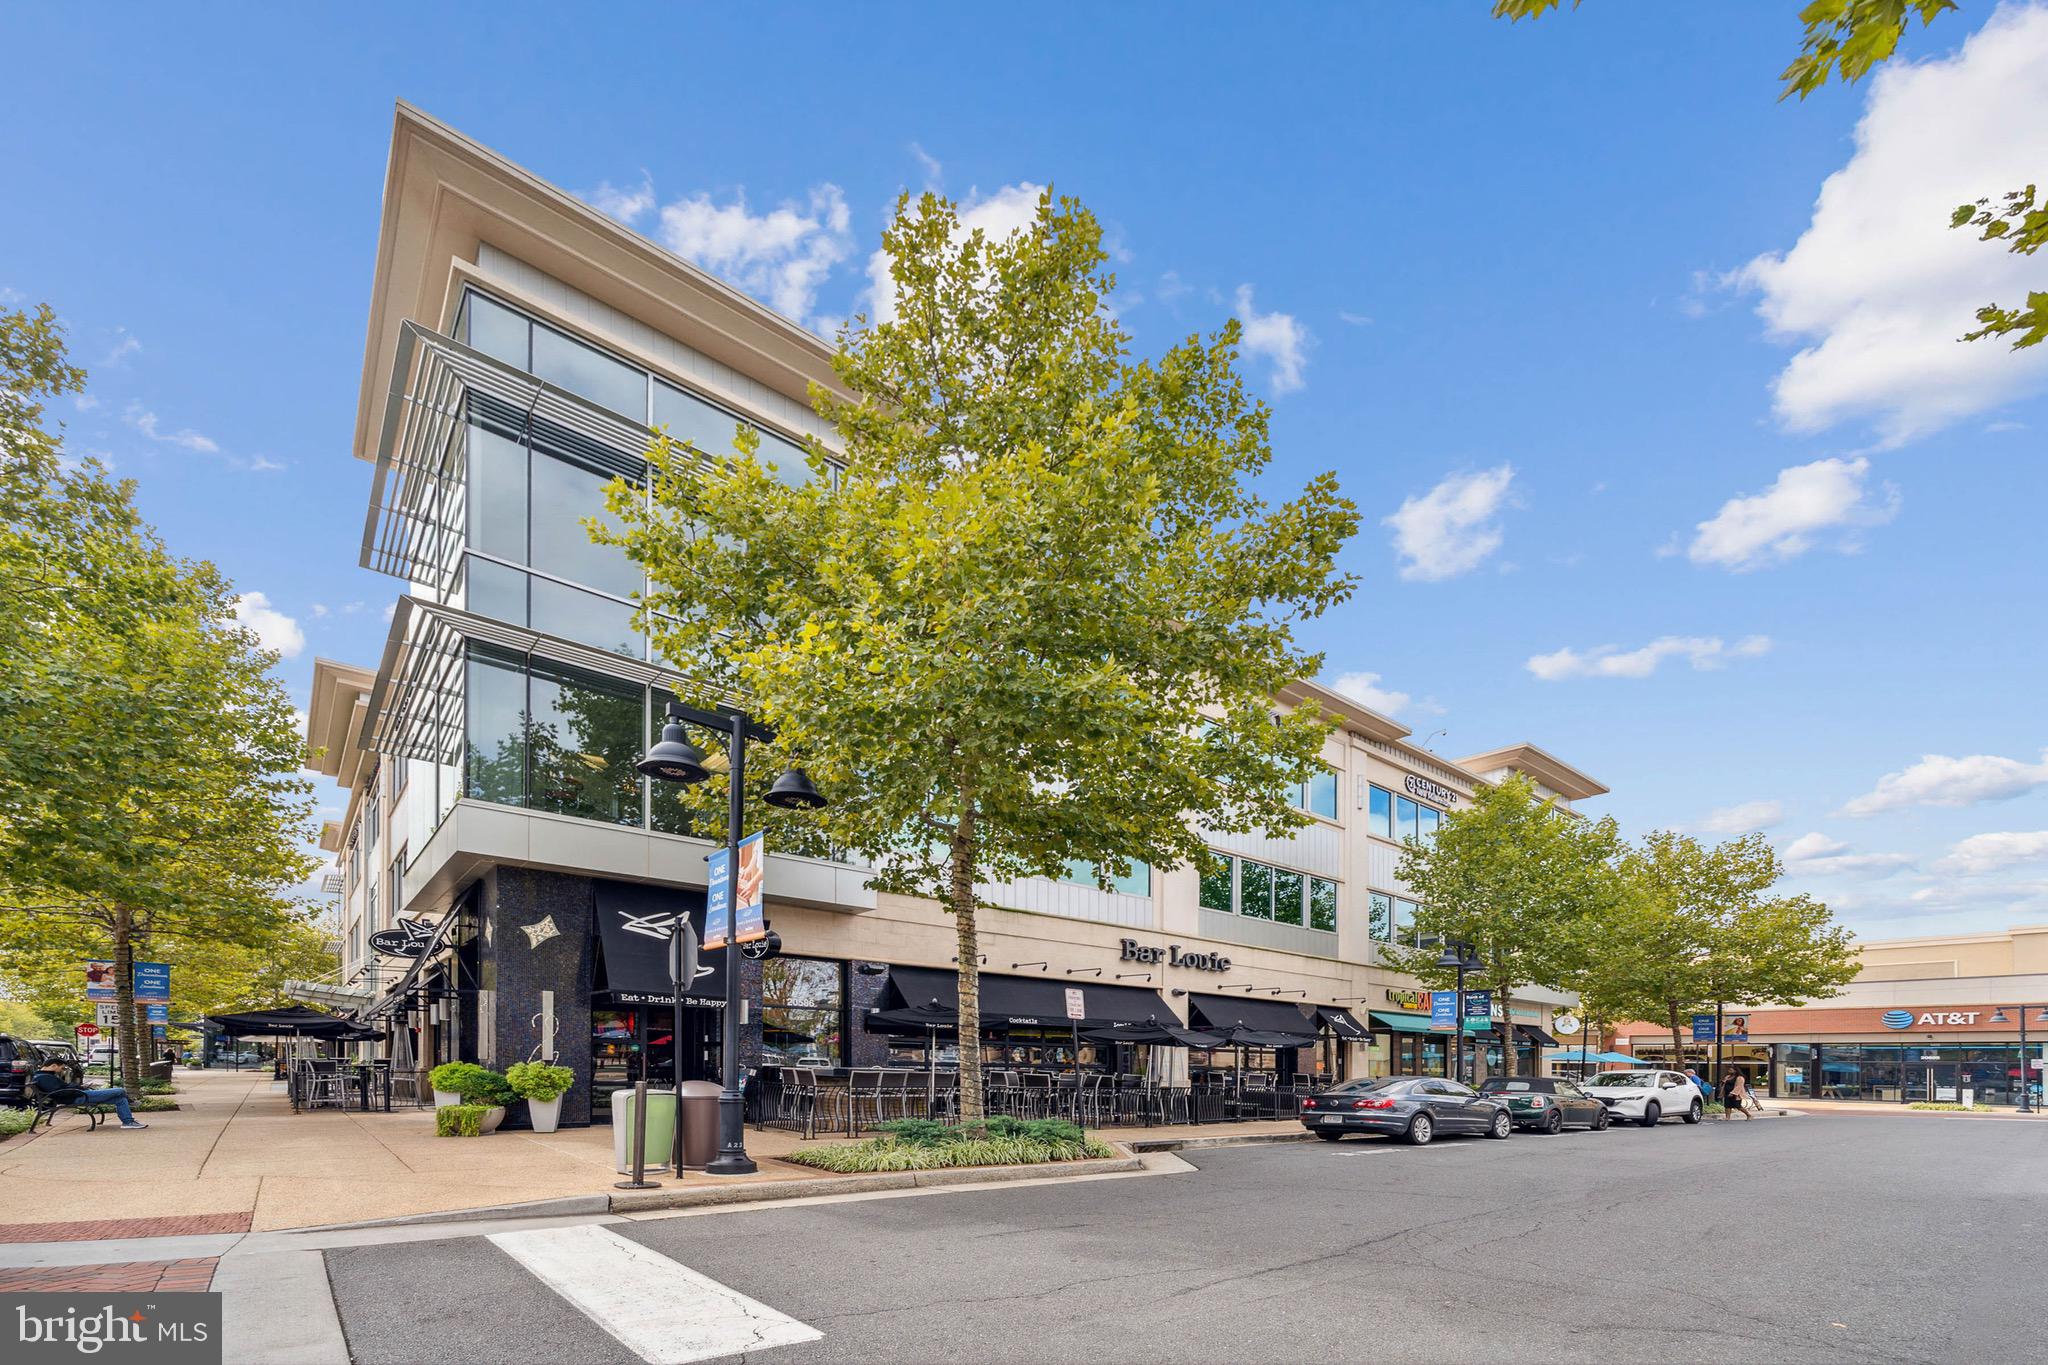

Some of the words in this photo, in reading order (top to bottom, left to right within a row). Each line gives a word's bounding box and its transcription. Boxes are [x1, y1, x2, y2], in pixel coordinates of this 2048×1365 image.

[1415, 777, 1451, 799] CENTURY
[714, 864, 726, 876] ONE
[712, 891, 724, 902] ONE
[376, 937, 399, 947] Bar
[1119, 938, 1166, 964] Bar
[1168, 944, 1232, 972] Louie
[621, 993, 640, 1002] Eat
[647, 995, 677, 1004] Drink
[686, 997, 698, 1005] Be
[699, 998, 728, 1008] Happy
[1386, 989, 1418, 1004] tropical
[1418, 991, 1432, 1010] CA
[103, 1015, 120, 1024] 15
[1917, 1012, 1981, 1025] AT&T
